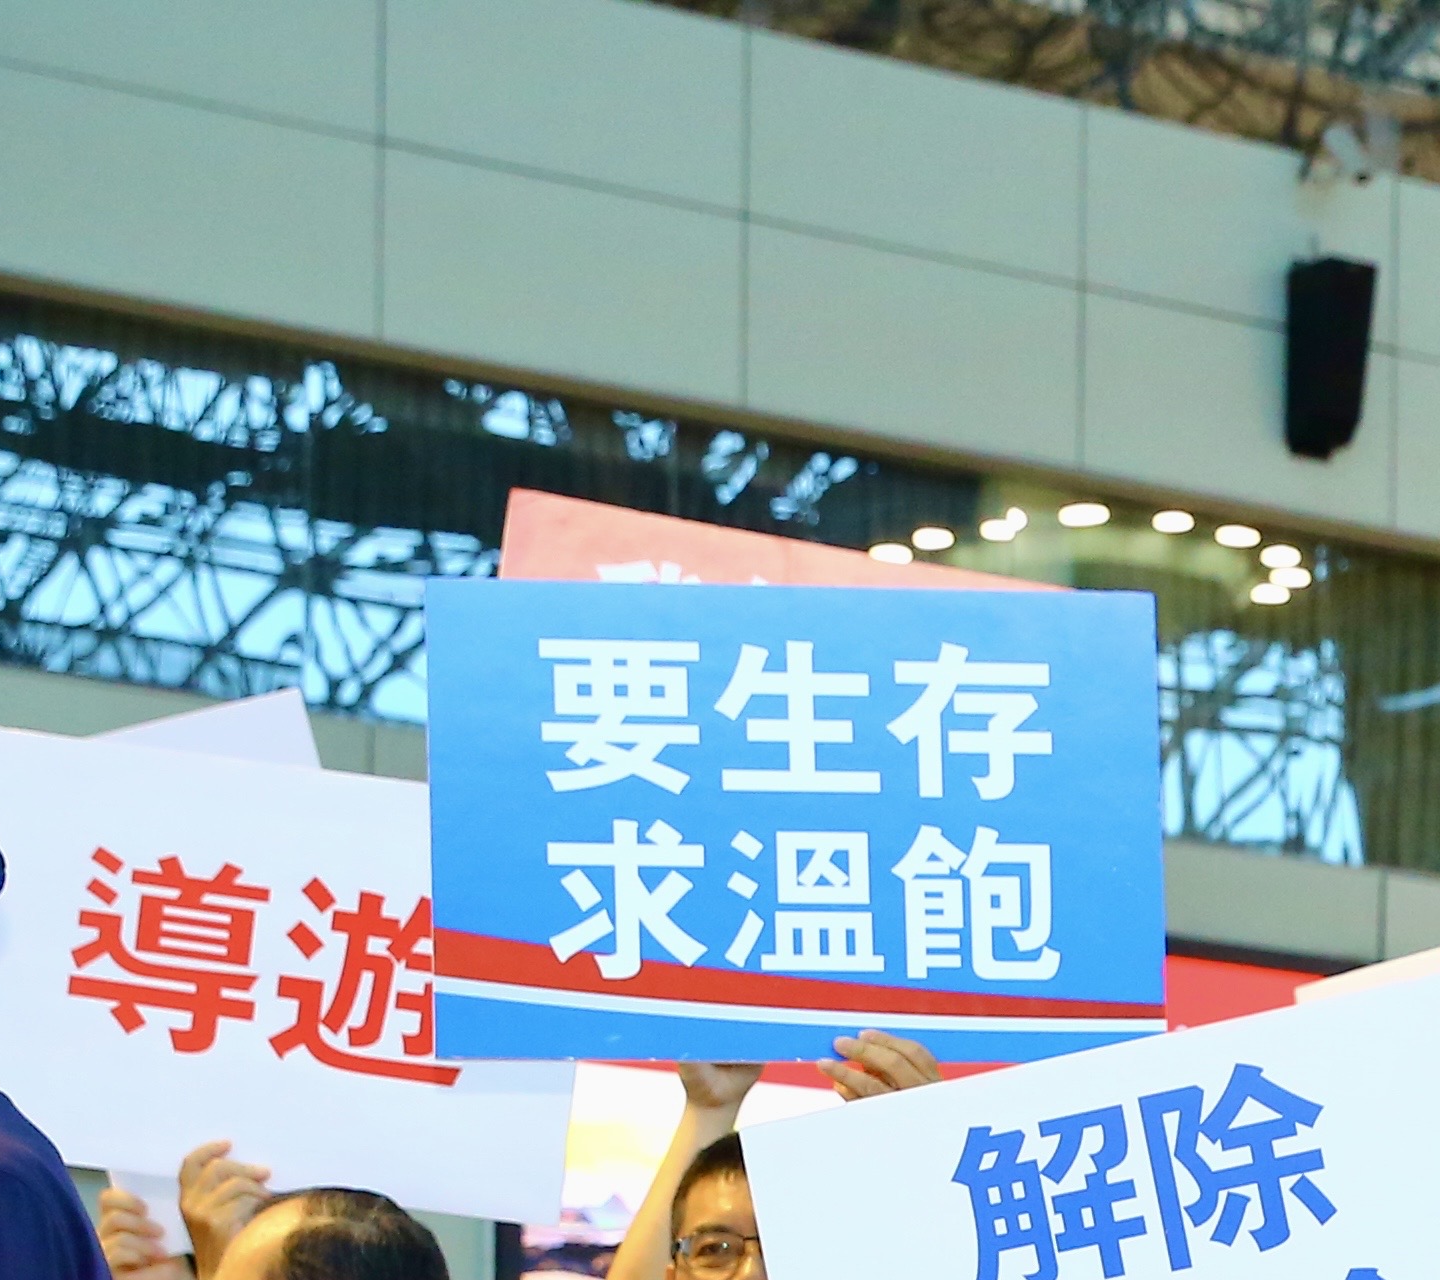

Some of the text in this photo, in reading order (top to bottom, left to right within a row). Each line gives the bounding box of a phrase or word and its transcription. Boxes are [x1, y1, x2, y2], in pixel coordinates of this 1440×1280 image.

[539, 639, 1052, 799] 要生存
[68, 847, 461, 1087] 導遊
[548, 821, 1059, 981] 求溫飽
